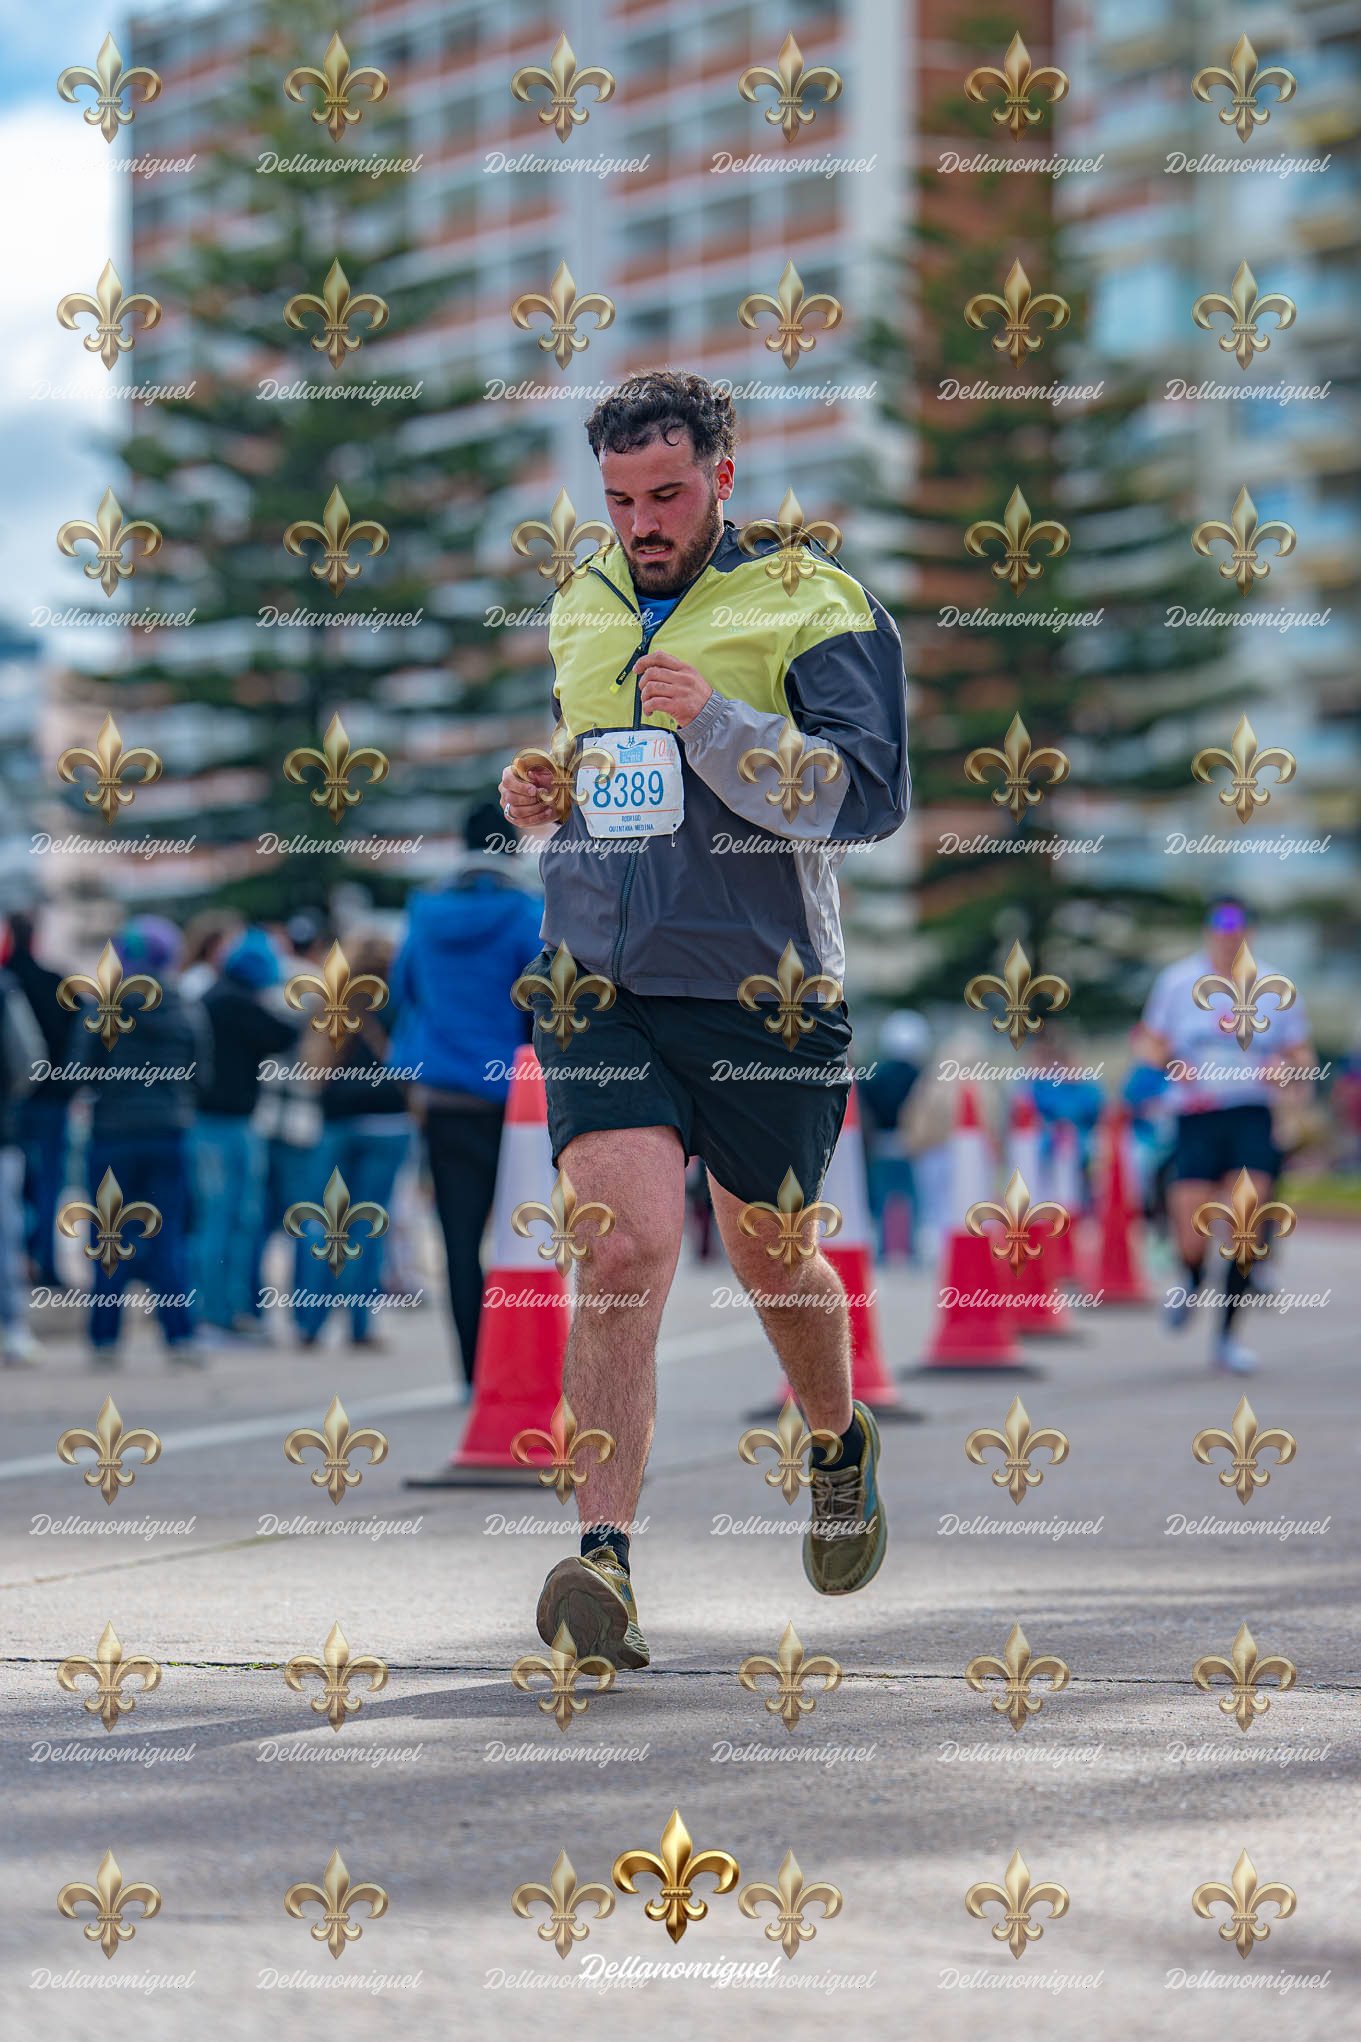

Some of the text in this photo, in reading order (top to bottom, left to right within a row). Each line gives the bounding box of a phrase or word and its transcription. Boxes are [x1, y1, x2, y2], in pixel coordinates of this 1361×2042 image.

[593, 770, 664, 808] 8389
[621, 814, 642, 822] RODRIGO
[608, 823, 655, 833] QUINTANA MEDINA
